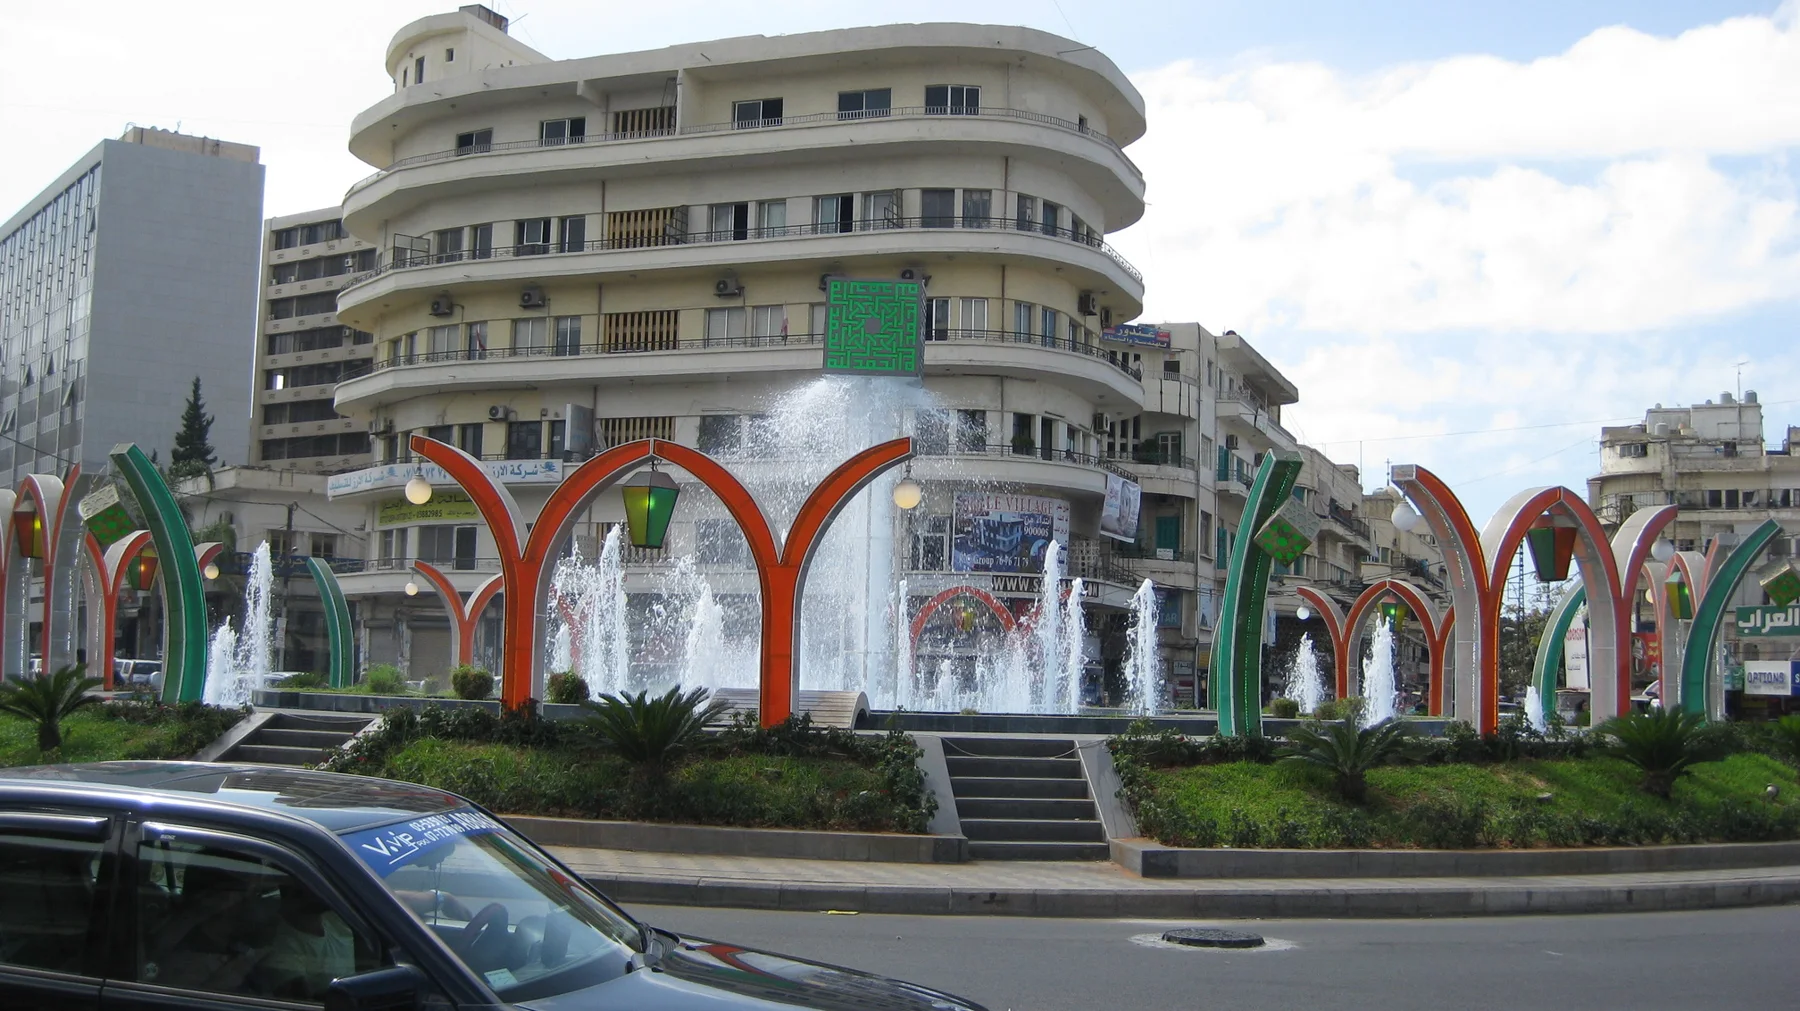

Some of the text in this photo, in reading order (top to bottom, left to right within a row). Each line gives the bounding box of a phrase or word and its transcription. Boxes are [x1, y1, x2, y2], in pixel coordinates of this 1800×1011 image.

[510, 464, 538, 479] شركة
[1006, 496, 1053, 515] VILLAGE
[1738, 608, 1800, 633] العراب
[1747, 671, 1785, 684] OPTIONS
